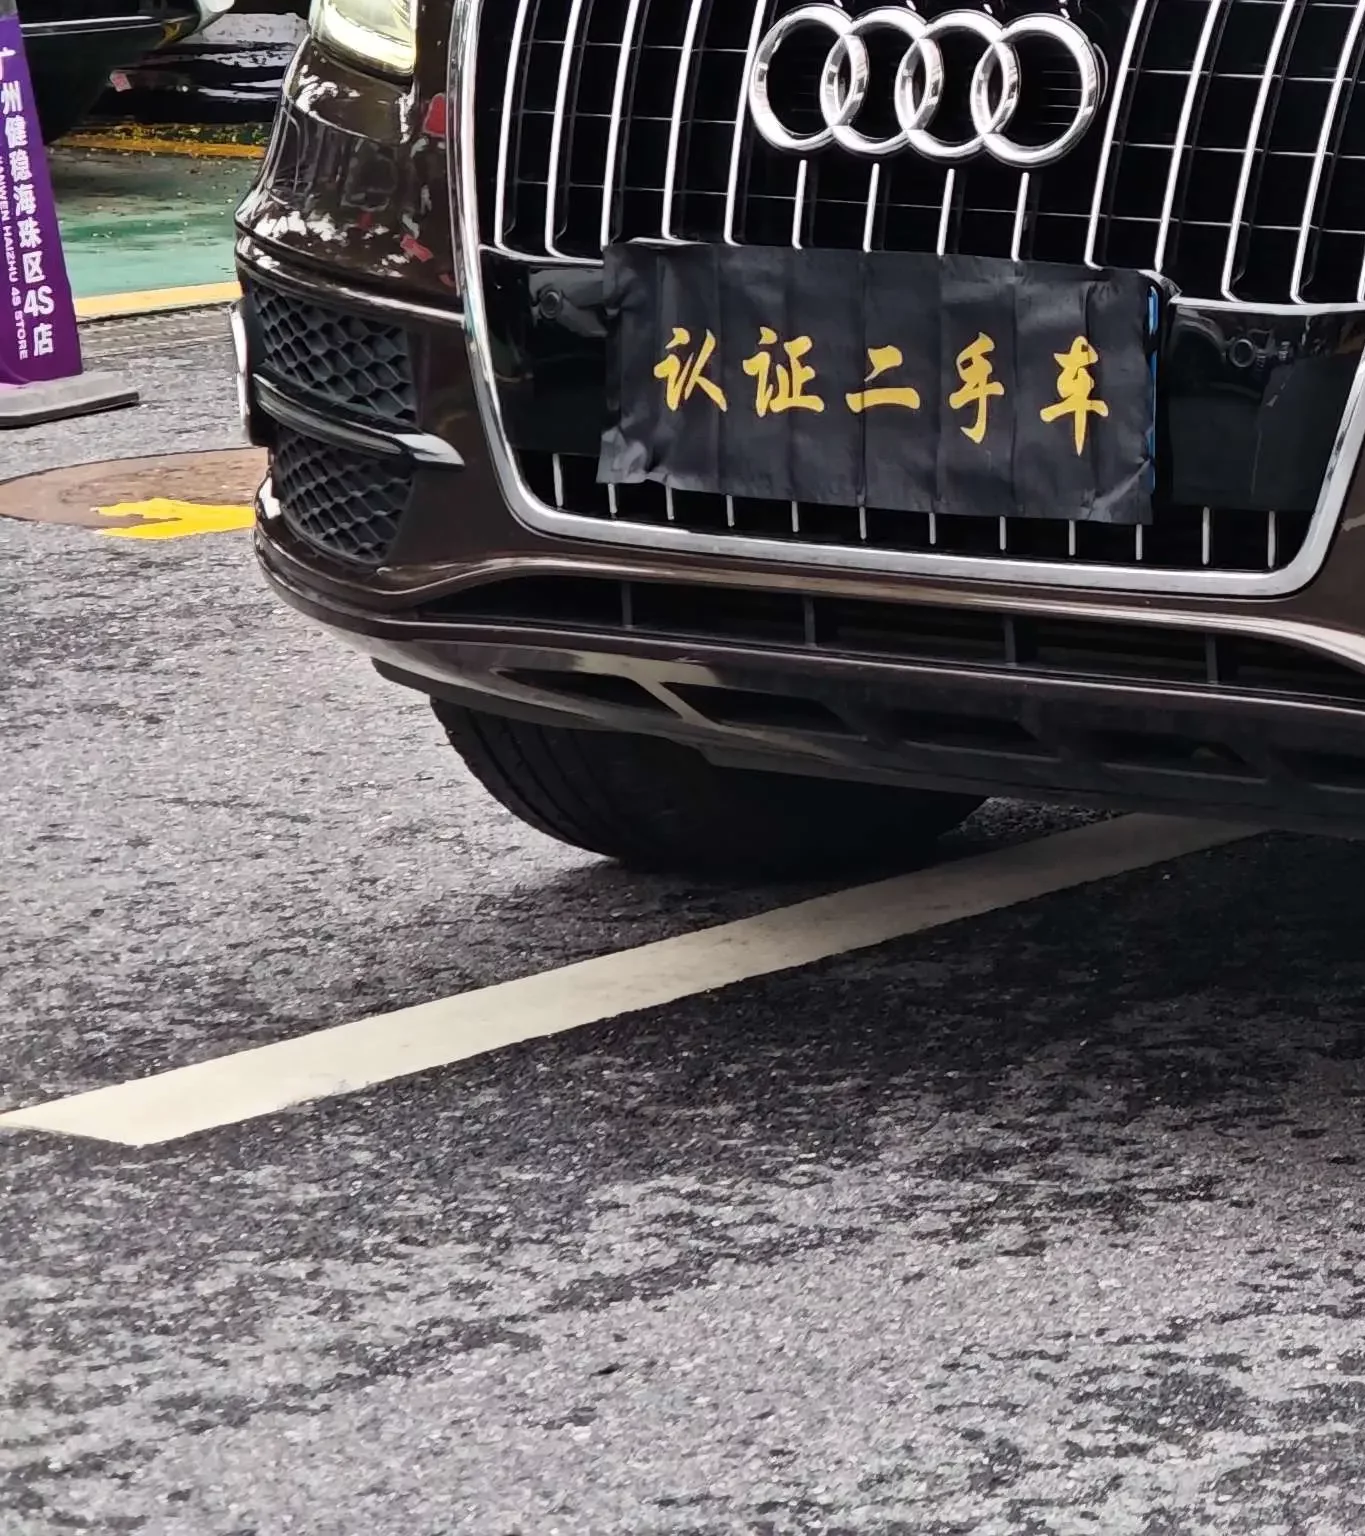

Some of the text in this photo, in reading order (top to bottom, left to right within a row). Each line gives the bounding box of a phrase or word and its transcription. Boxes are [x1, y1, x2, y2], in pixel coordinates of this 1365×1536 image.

[14, 310, 28, 360] STORE
[653, 327, 1109, 456] 认证二手车
